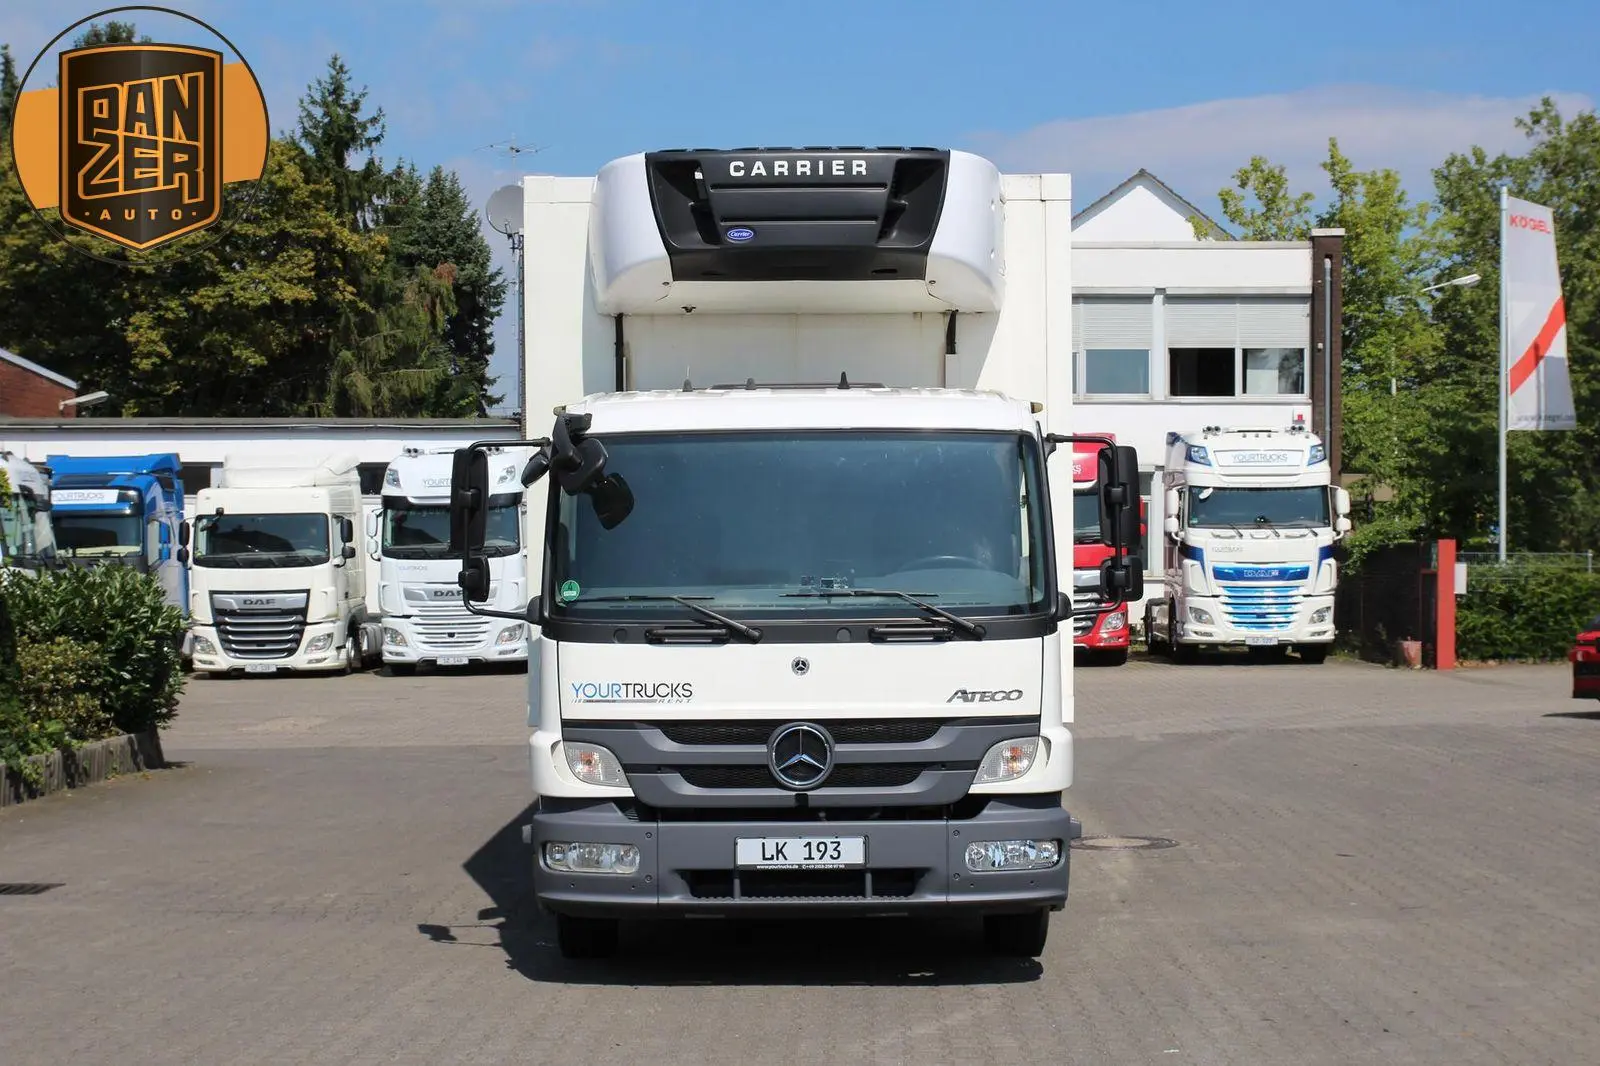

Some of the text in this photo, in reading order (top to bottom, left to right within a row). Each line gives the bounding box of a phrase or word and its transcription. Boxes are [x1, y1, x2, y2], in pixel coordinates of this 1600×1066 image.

[729, 160, 868, 177] CARRIER
[571, 682, 694, 699] YOURTRUCKS
[761, 841, 842, 861] LK 193
